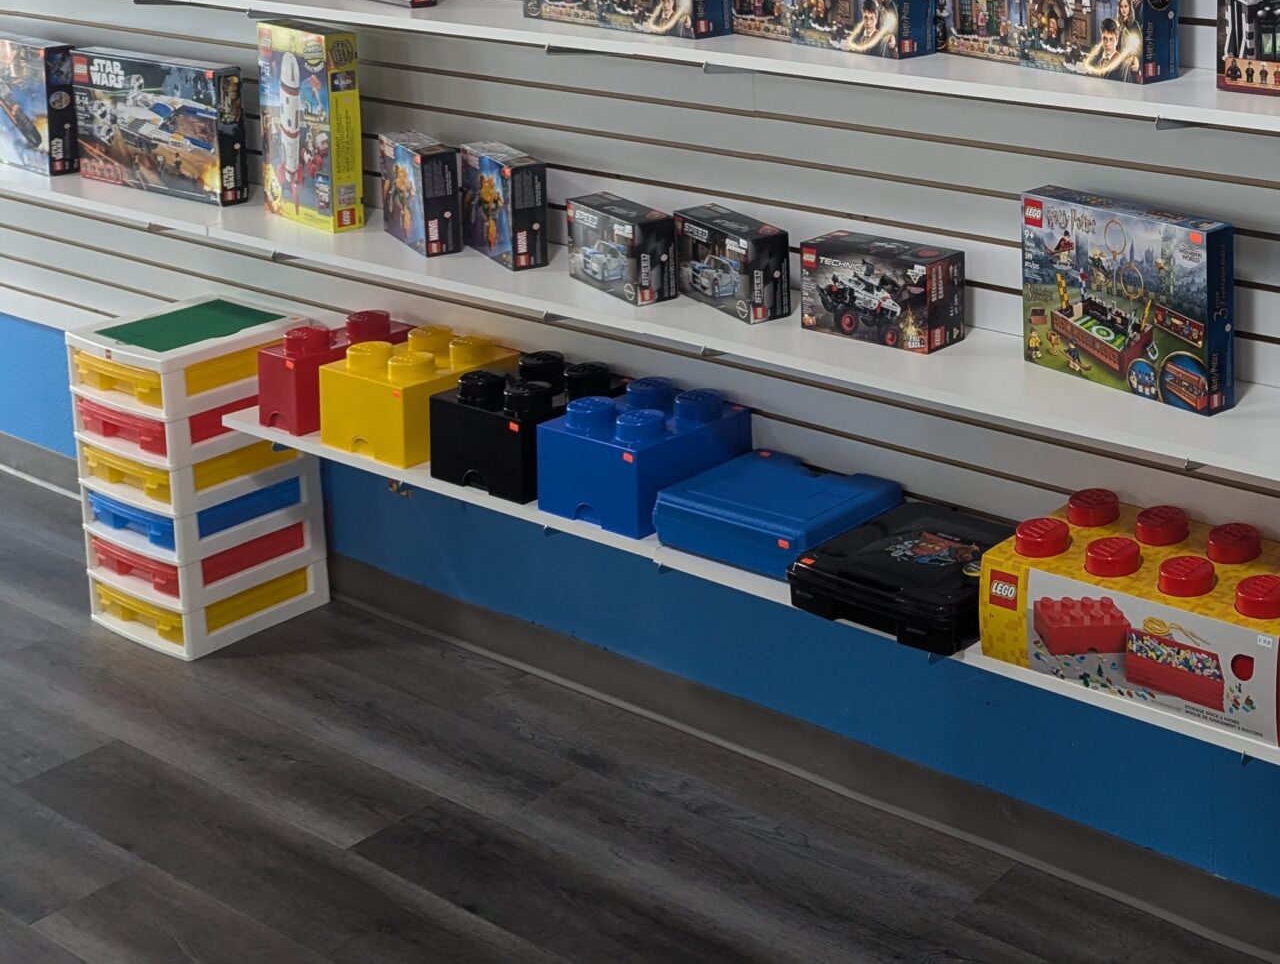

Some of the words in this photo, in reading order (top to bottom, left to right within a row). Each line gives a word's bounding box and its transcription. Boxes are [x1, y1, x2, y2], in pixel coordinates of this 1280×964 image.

[90, 58, 124, 76] STAR
[90, 70, 125, 88] WARS
[342, 210, 350, 225] LEGO
[575, 209, 598, 225] SPEED
[1026, 207, 1041, 219] LEGO
[1047, 206, 1070, 231] Harry
[1070, 209, 1097, 234] Potter
[428, 219, 439, 241] MARVEL
[684, 222, 709, 238] SPEED
[517, 231, 527, 254] MARVEL
[803, 253, 816, 262] LEGO
[819, 256, 863, 271] TECHNIC
[641, 253, 650, 286] SPEED
[754, 270, 764, 304] SPEED
[991, 580, 1016, 600] LEGO
[1224, 716, 1240, 725] KNOBS
